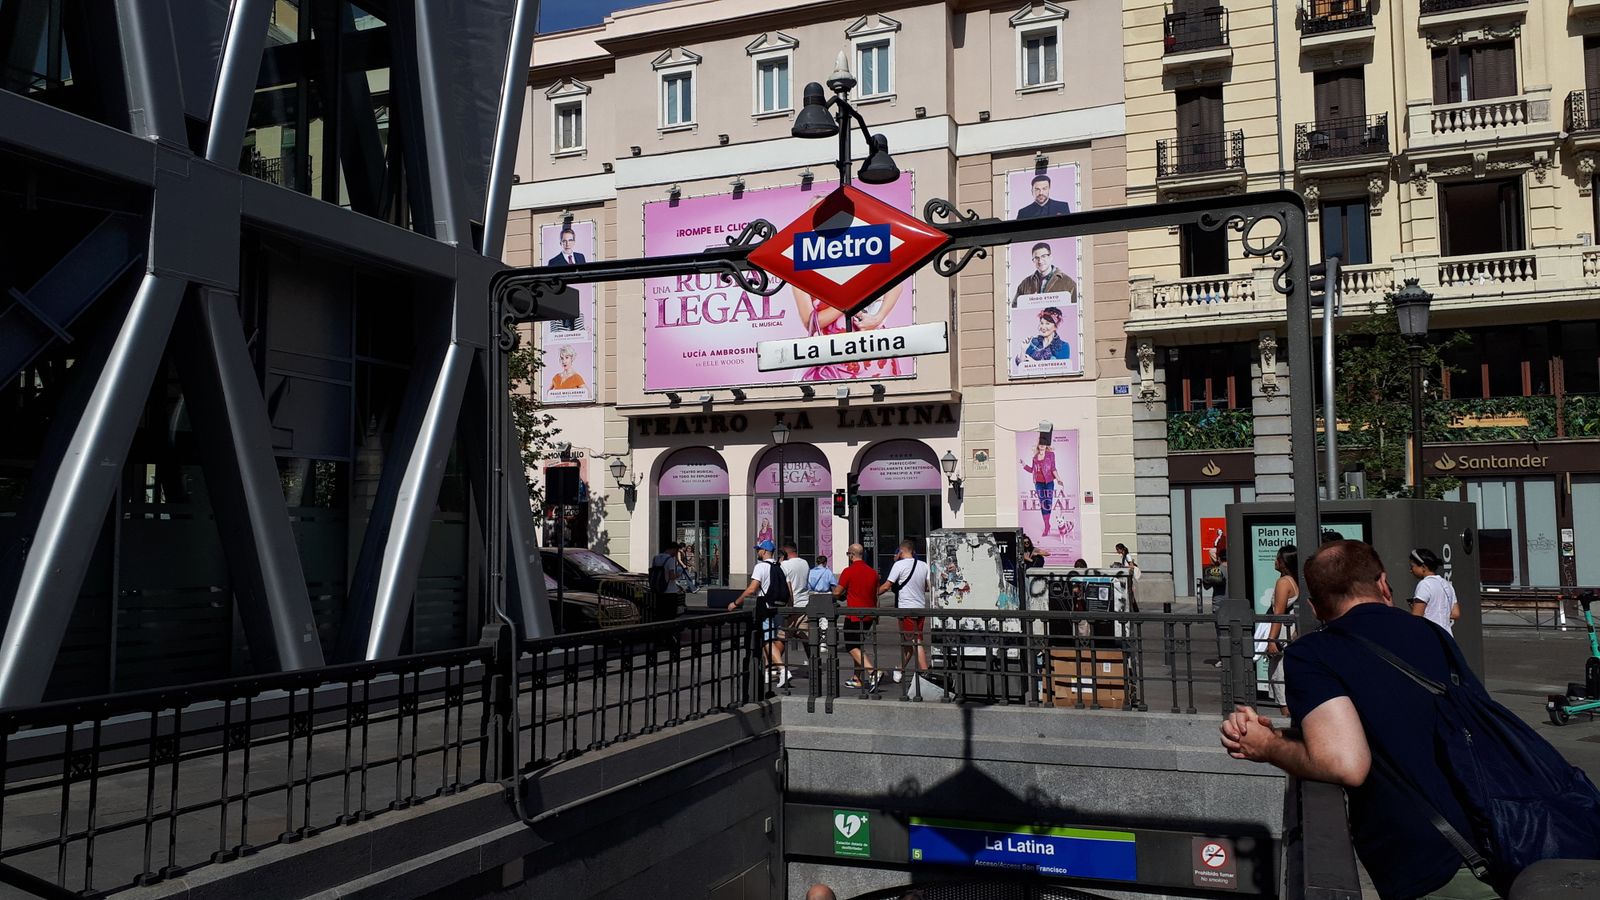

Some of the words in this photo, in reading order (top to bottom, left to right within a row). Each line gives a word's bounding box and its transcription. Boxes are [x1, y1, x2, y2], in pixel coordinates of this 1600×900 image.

[676, 226, 711, 238] ¡ROMPE
[714, 225, 724, 233] EL
[802, 235, 883, 262] Metro
[653, 286, 670, 294] UNA
[654, 290, 786, 328] LEGAL
[793, 343, 819, 360] La
[830, 334, 906, 357] Latina
[683, 349, 707, 358] LUCÍA
[637, 413, 748, 435] TEATRO
[837, 403, 955, 428] LATINA
[1459, 454, 1549, 469] Santander
[1030, 490, 1065, 498] RUBIA
[1022, 499, 1075, 511] LEGAL
[1258, 528, 1280, 537] Plan
[1258, 538, 1293, 547] Madrid
[985, 836, 1003, 851] La
[1007, 837, 1055, 855] Latina
[914, 850, 920, 858] 5
[1036, 865, 1067, 874] Francisco
